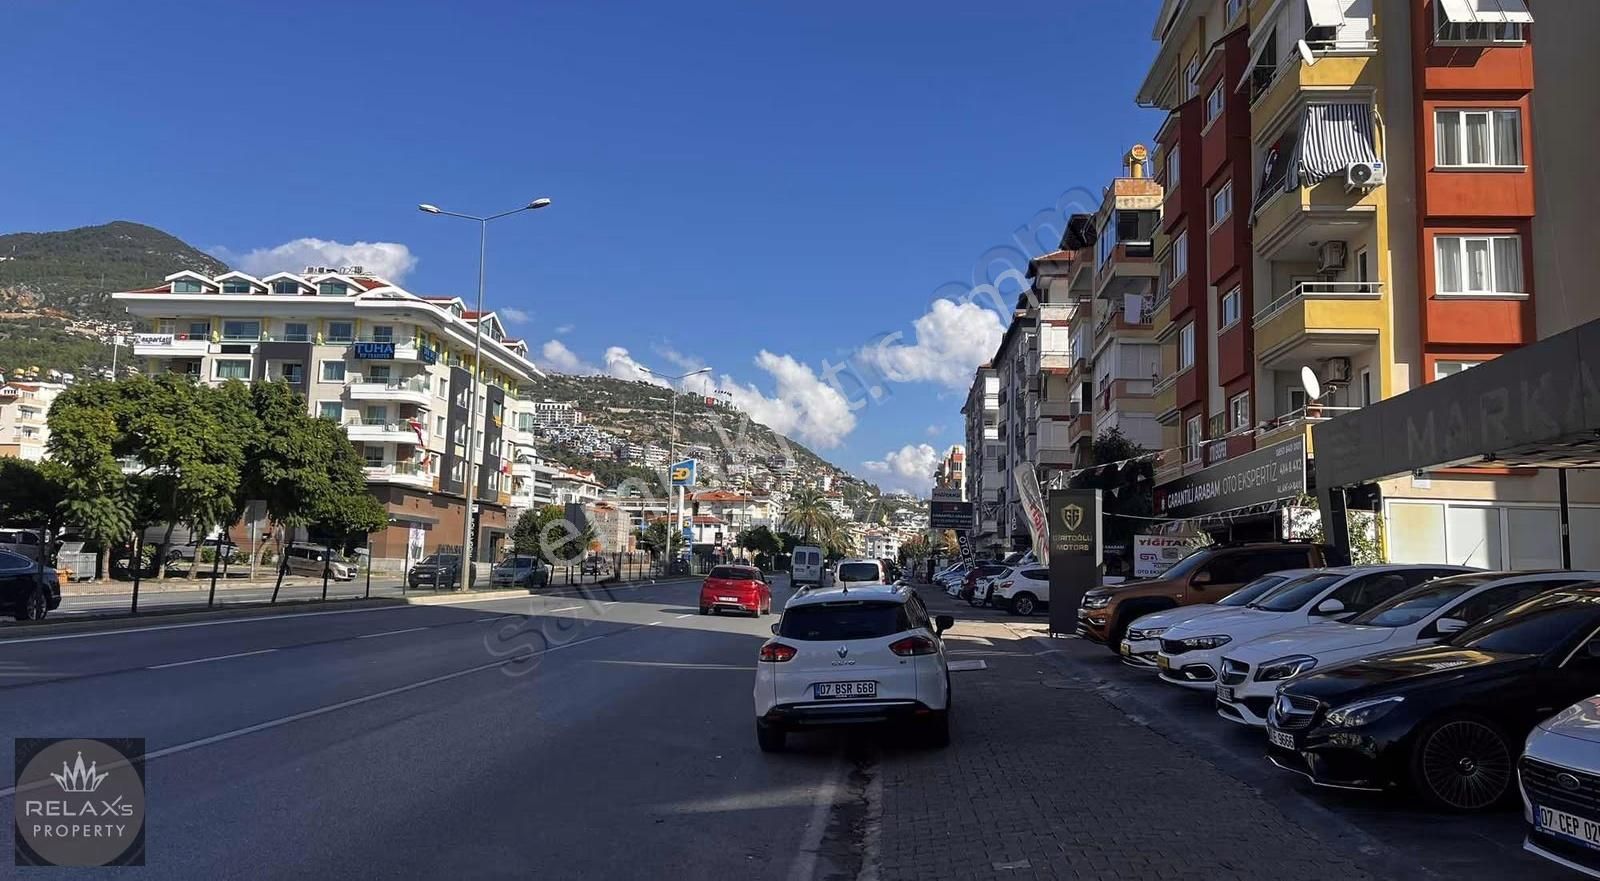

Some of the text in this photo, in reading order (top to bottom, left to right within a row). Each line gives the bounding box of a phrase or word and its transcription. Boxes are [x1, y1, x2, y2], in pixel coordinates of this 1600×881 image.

[358, 344, 393, 353] TUHA
[1167, 483, 1193, 508] GARANTİLİ
[1194, 479, 1220, 503] ARABAM
[1222, 475, 1237, 494] OTO
[1238, 460, 1277, 491] EKSPERTİZ
[959, 536, 970, 555] OTO
[820, 682, 874, 694] 07 BSR 668
[1541, 807, 1600, 843] 07 CEP 02
